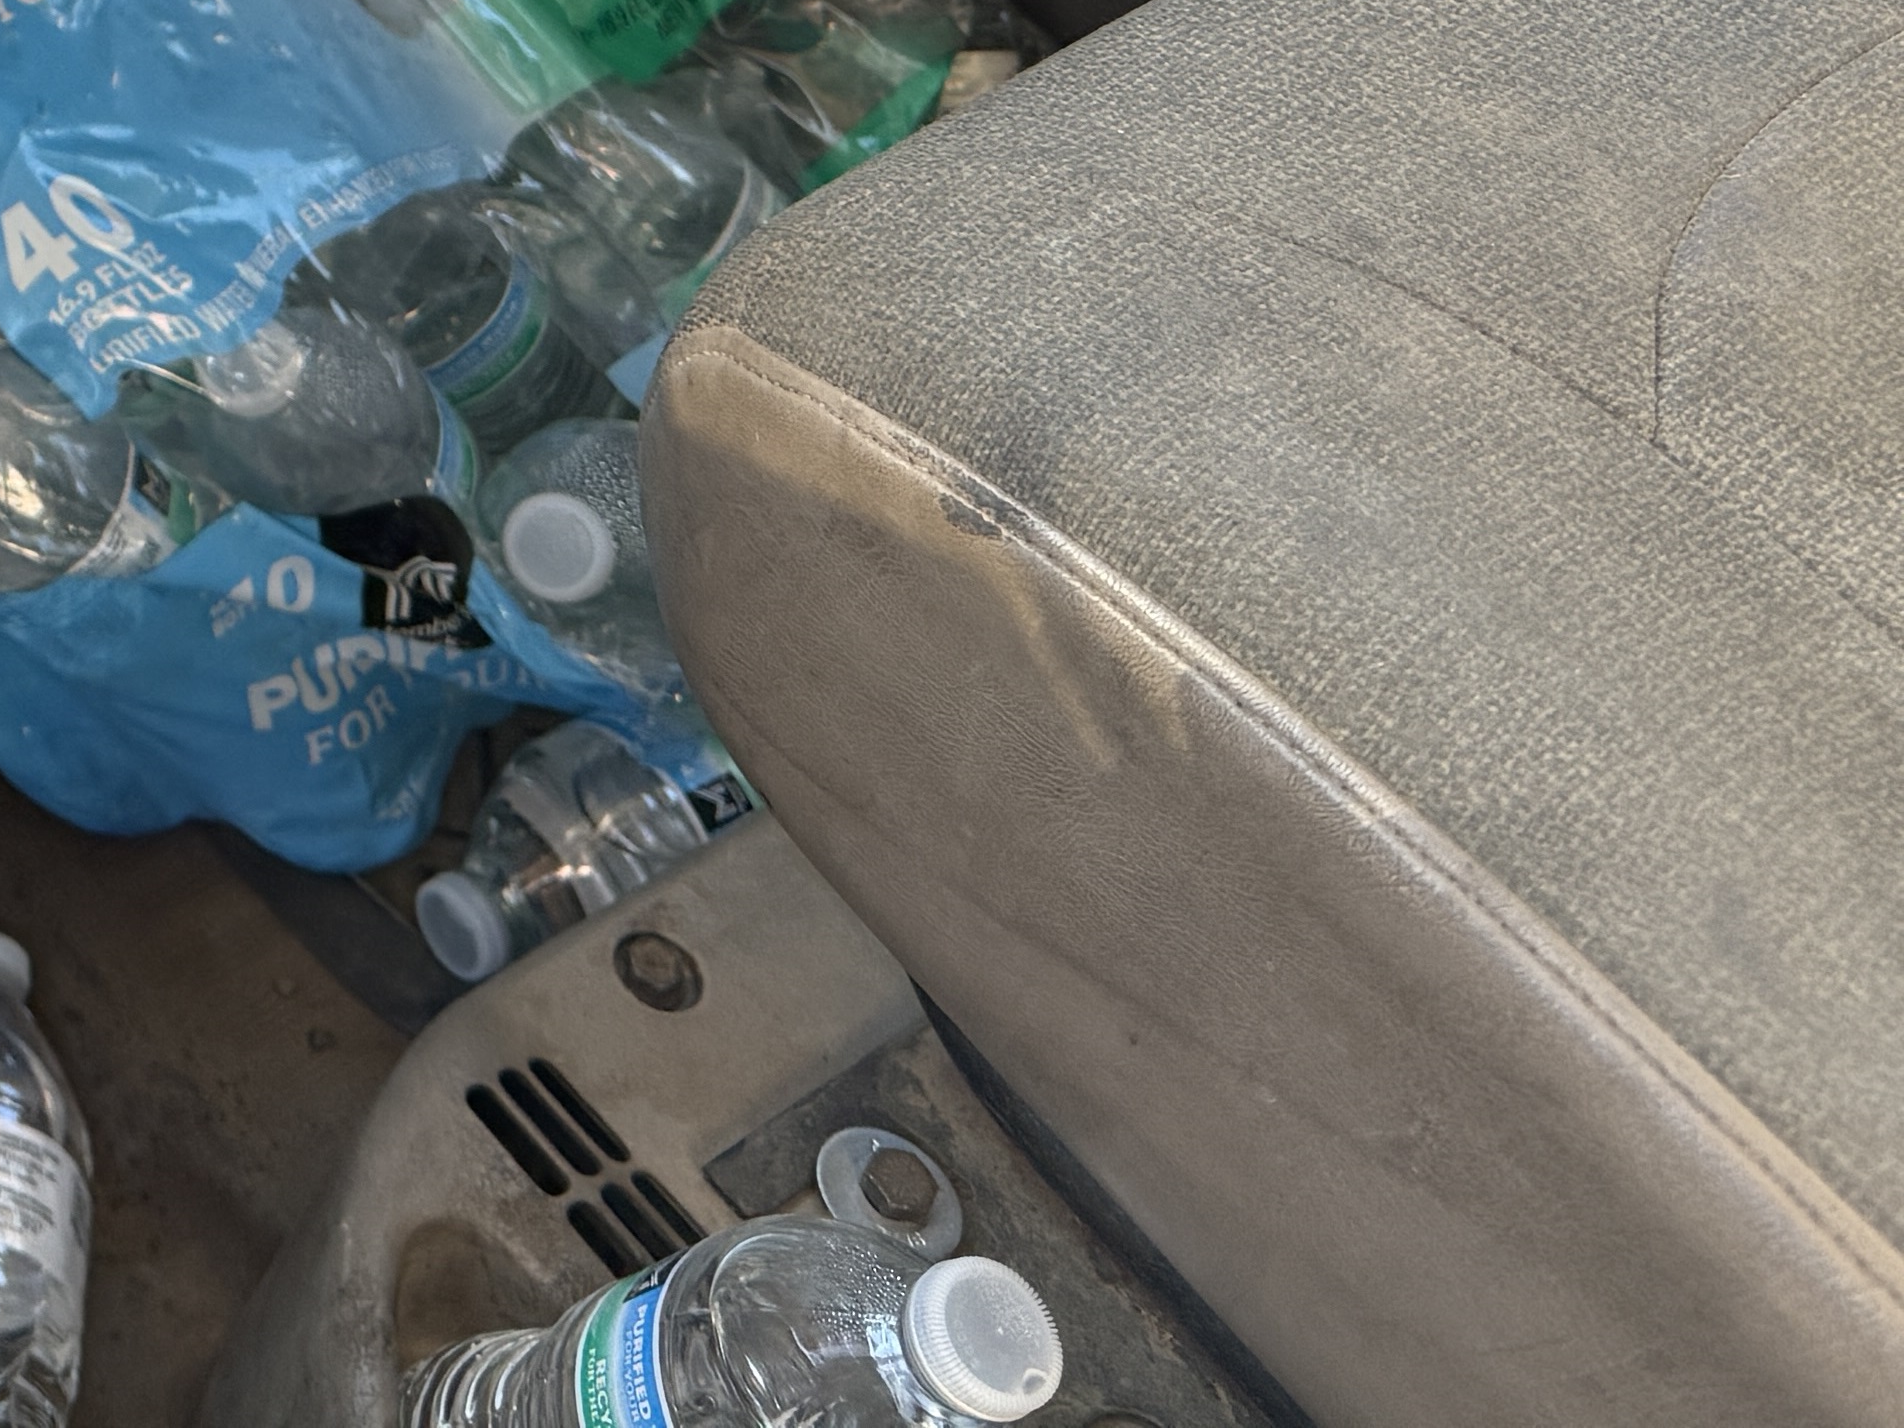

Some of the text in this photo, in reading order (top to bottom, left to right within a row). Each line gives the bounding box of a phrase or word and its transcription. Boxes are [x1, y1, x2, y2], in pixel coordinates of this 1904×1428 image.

[0, 173, 135, 293] 40
[304, 684, 397, 766] FOR
[632, 1304, 652, 1421] PURIFIED
